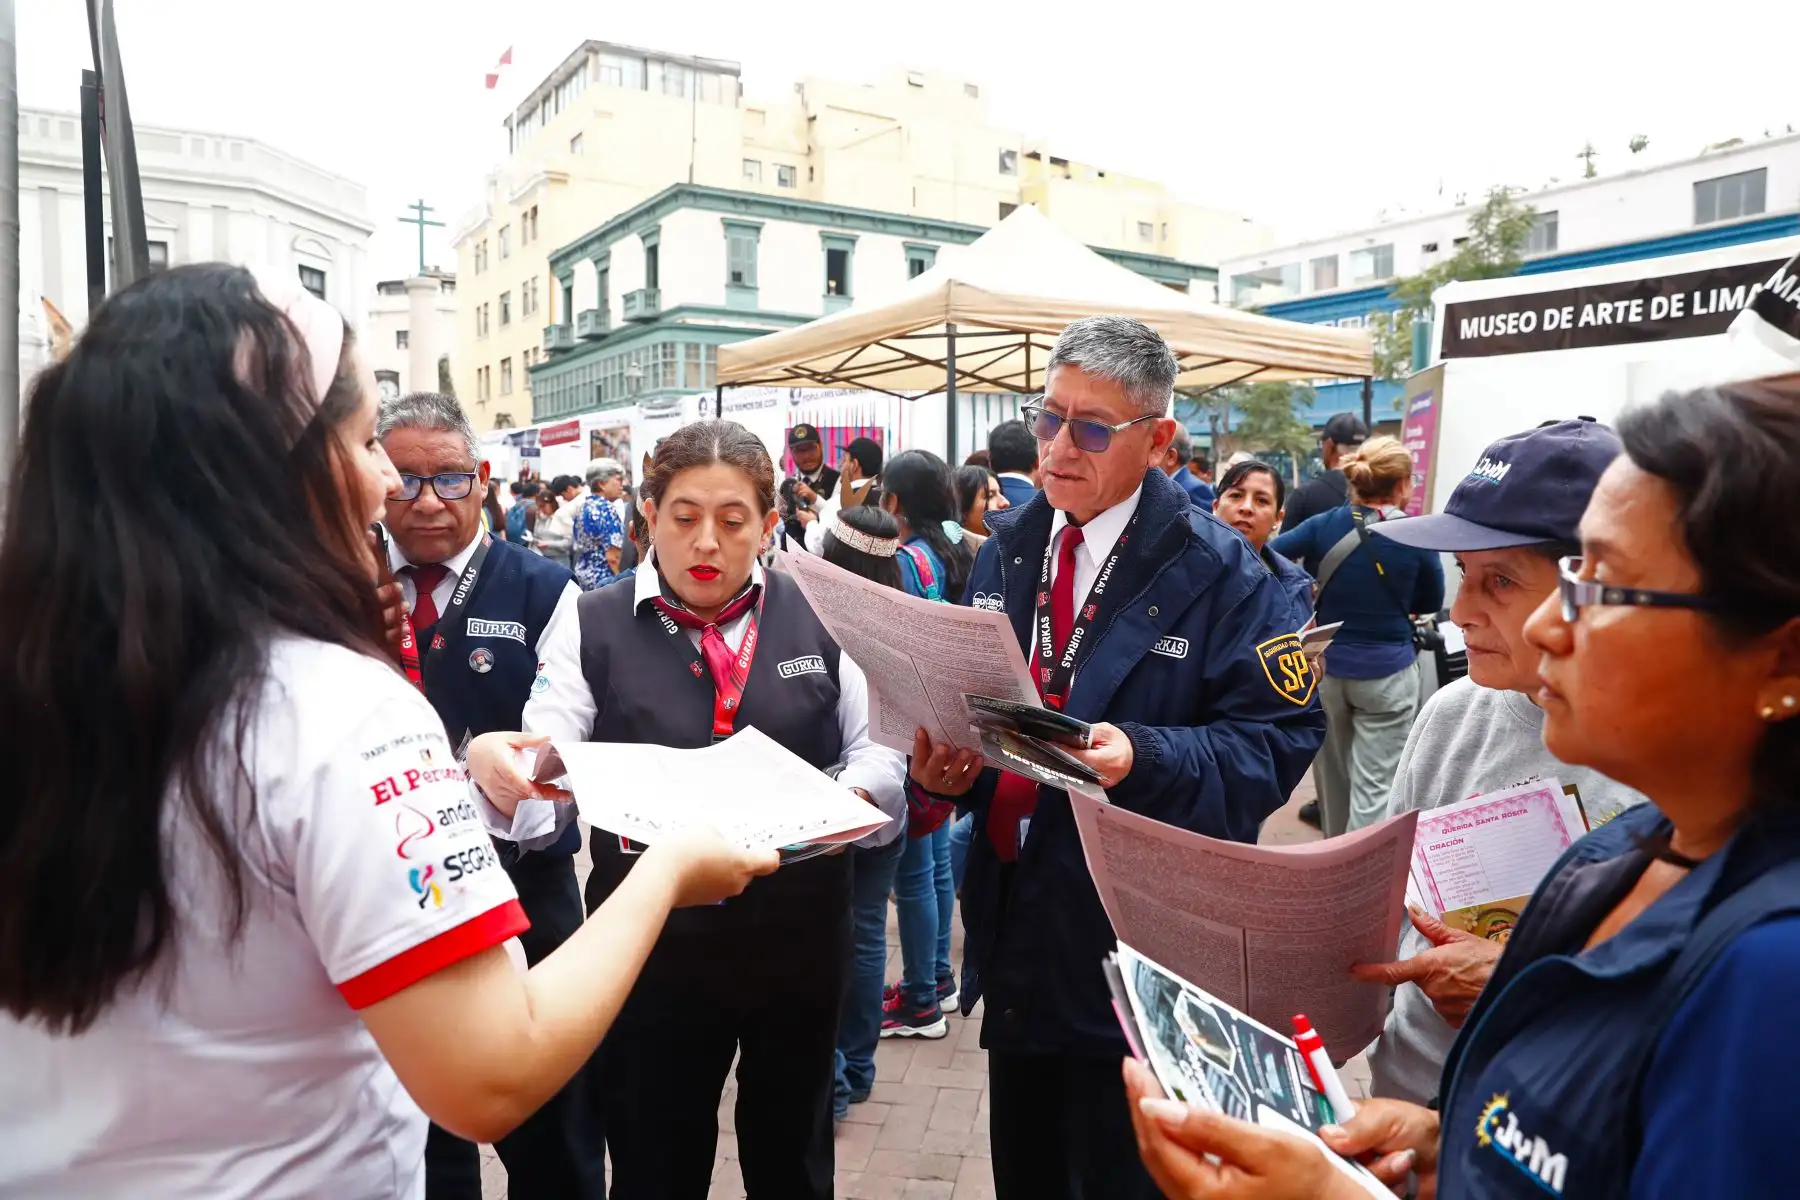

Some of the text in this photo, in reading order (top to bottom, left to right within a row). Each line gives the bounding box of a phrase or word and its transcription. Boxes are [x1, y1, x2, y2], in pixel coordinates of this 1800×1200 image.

[1460, 310, 1538, 340] MUSEO
[1543, 305, 1573, 331] DE
[1578, 296, 1643, 328] ARTE
[1649, 292, 1685, 320] DE
[452, 566, 477, 606] GURKAS
[987, 598, 1002, 607] ISO
[470, 621, 526, 642] GURKAS
[738, 627, 756, 669] GURKAS
[1041, 615, 1053, 658] GURKAS
[1061, 626, 1085, 669] GURKAS
[783, 655, 826, 676] GURKAS
[1278, 650, 1309, 692] SP
[369, 777, 402, 806] El
[1441, 807, 1529, 836] QUERIDA SANTA ROSITA
[1429, 837, 1464, 852] ORACIÓN
